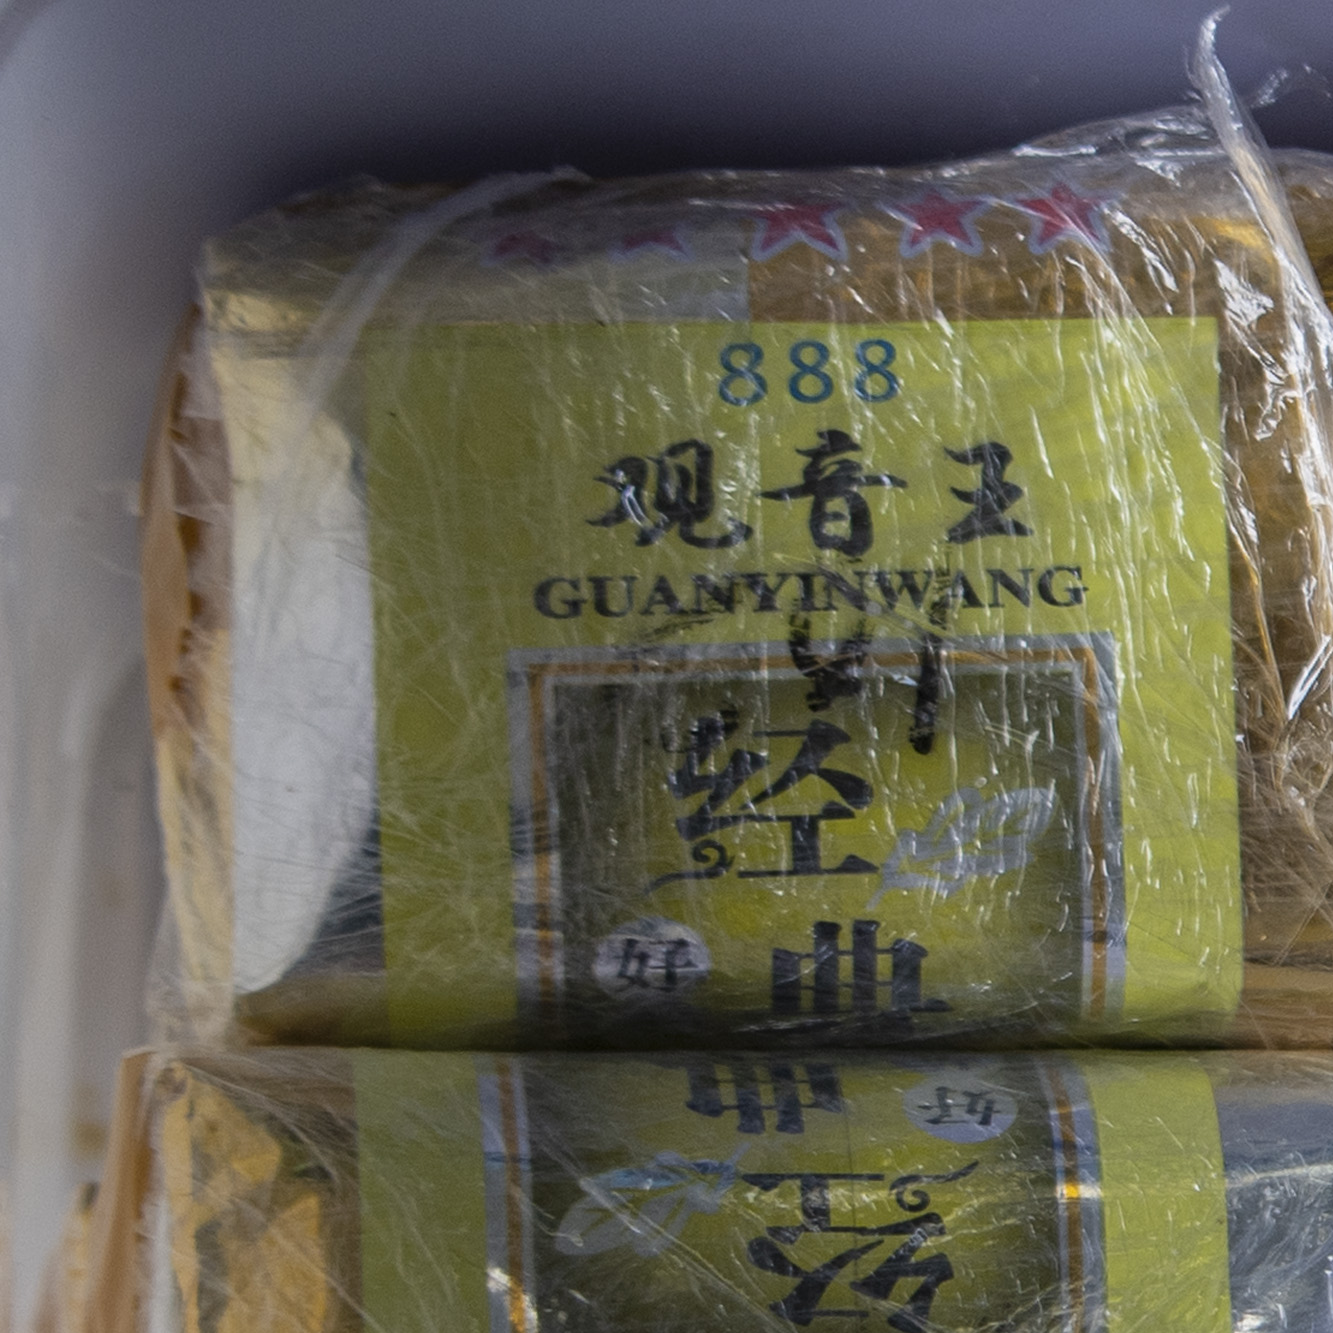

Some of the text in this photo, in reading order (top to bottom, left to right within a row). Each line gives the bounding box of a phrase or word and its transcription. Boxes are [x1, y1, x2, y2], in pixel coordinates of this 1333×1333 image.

[717, 337, 902, 408] 888
[586, 430, 1034, 557] 观音王
[533, 565, 1089, 621] GUANYINWANG
